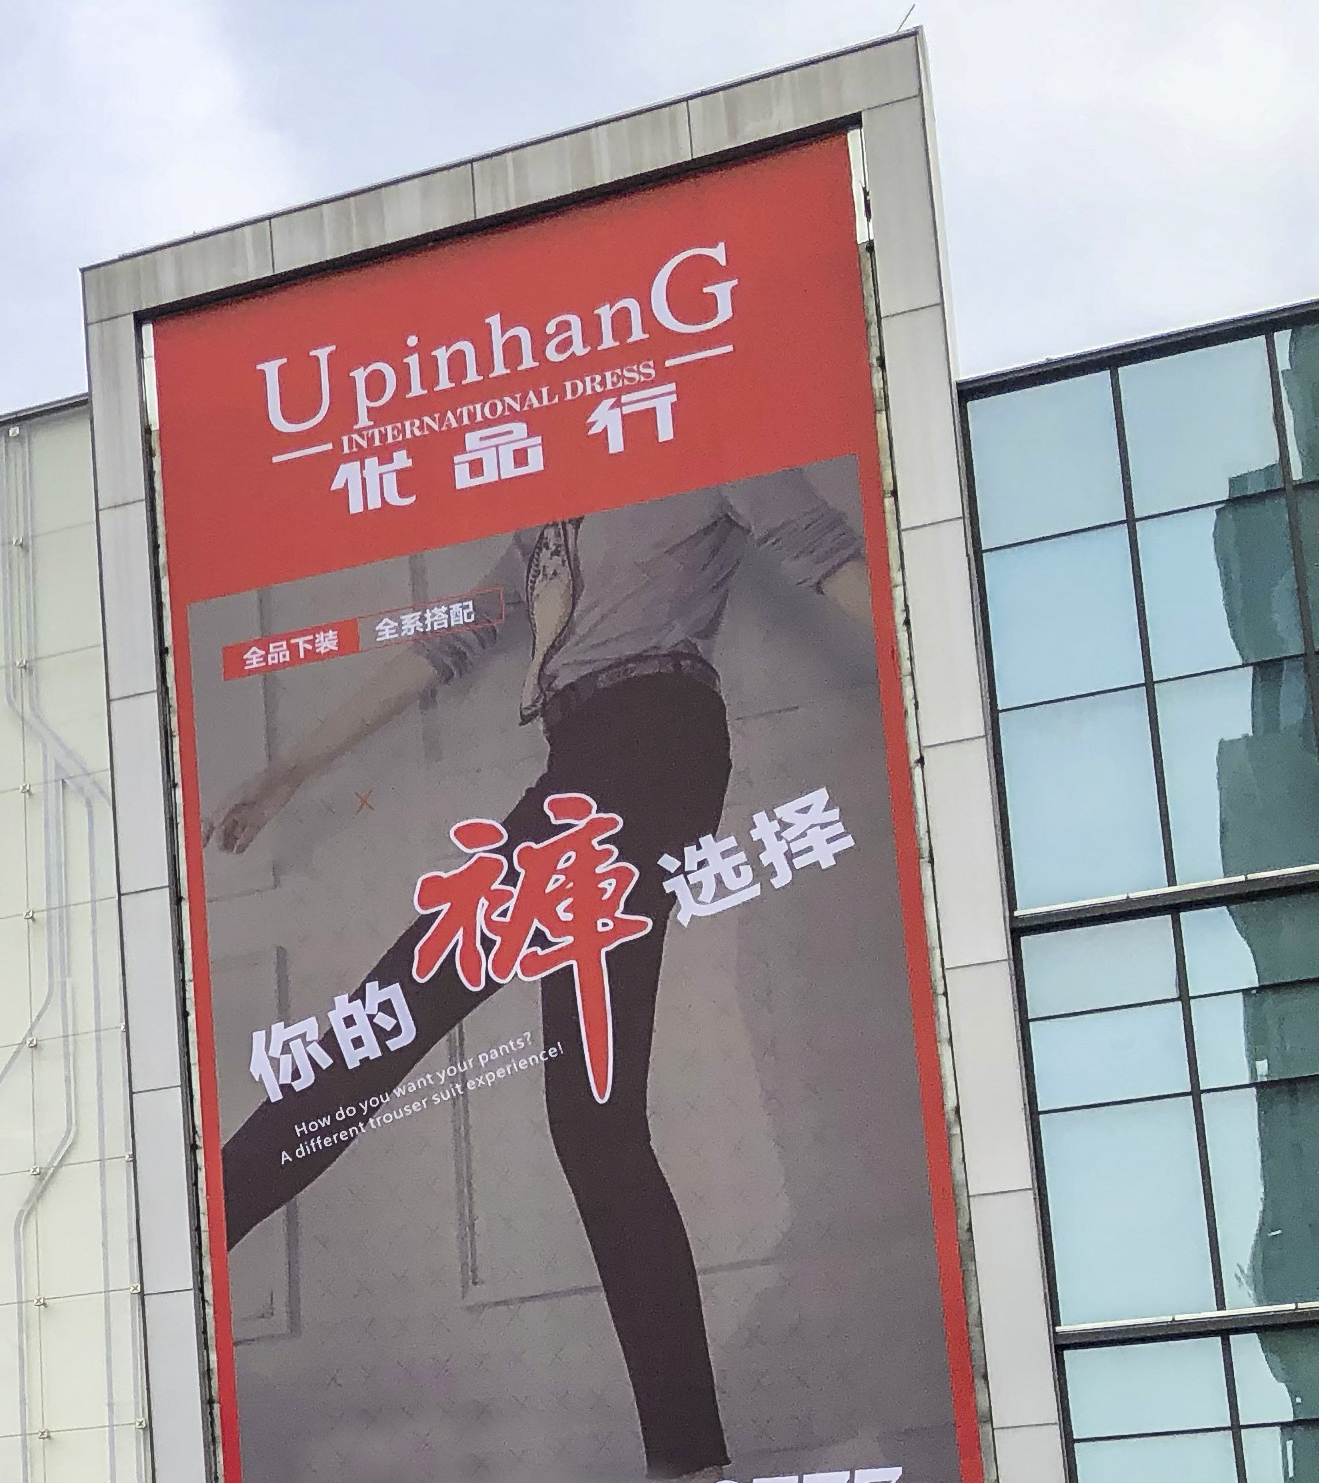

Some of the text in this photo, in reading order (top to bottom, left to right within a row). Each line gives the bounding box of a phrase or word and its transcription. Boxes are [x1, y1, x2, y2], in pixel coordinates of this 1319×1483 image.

[257, 242, 739, 434] UpinhanG
[330, 382, 678, 515] 优品行
[341, 360, 656, 454] INTERNATIONAL DRESS
[242, 629, 340, 670] 全品下装
[375, 600, 475, 642] 全系搭配
[249, 980, 417, 1103] 你的
[657, 788, 856, 928] 选择
[280, 1042, 565, 1165] A different trouser suit experience!
[294, 1031, 533, 1138] How do you want your pants?
